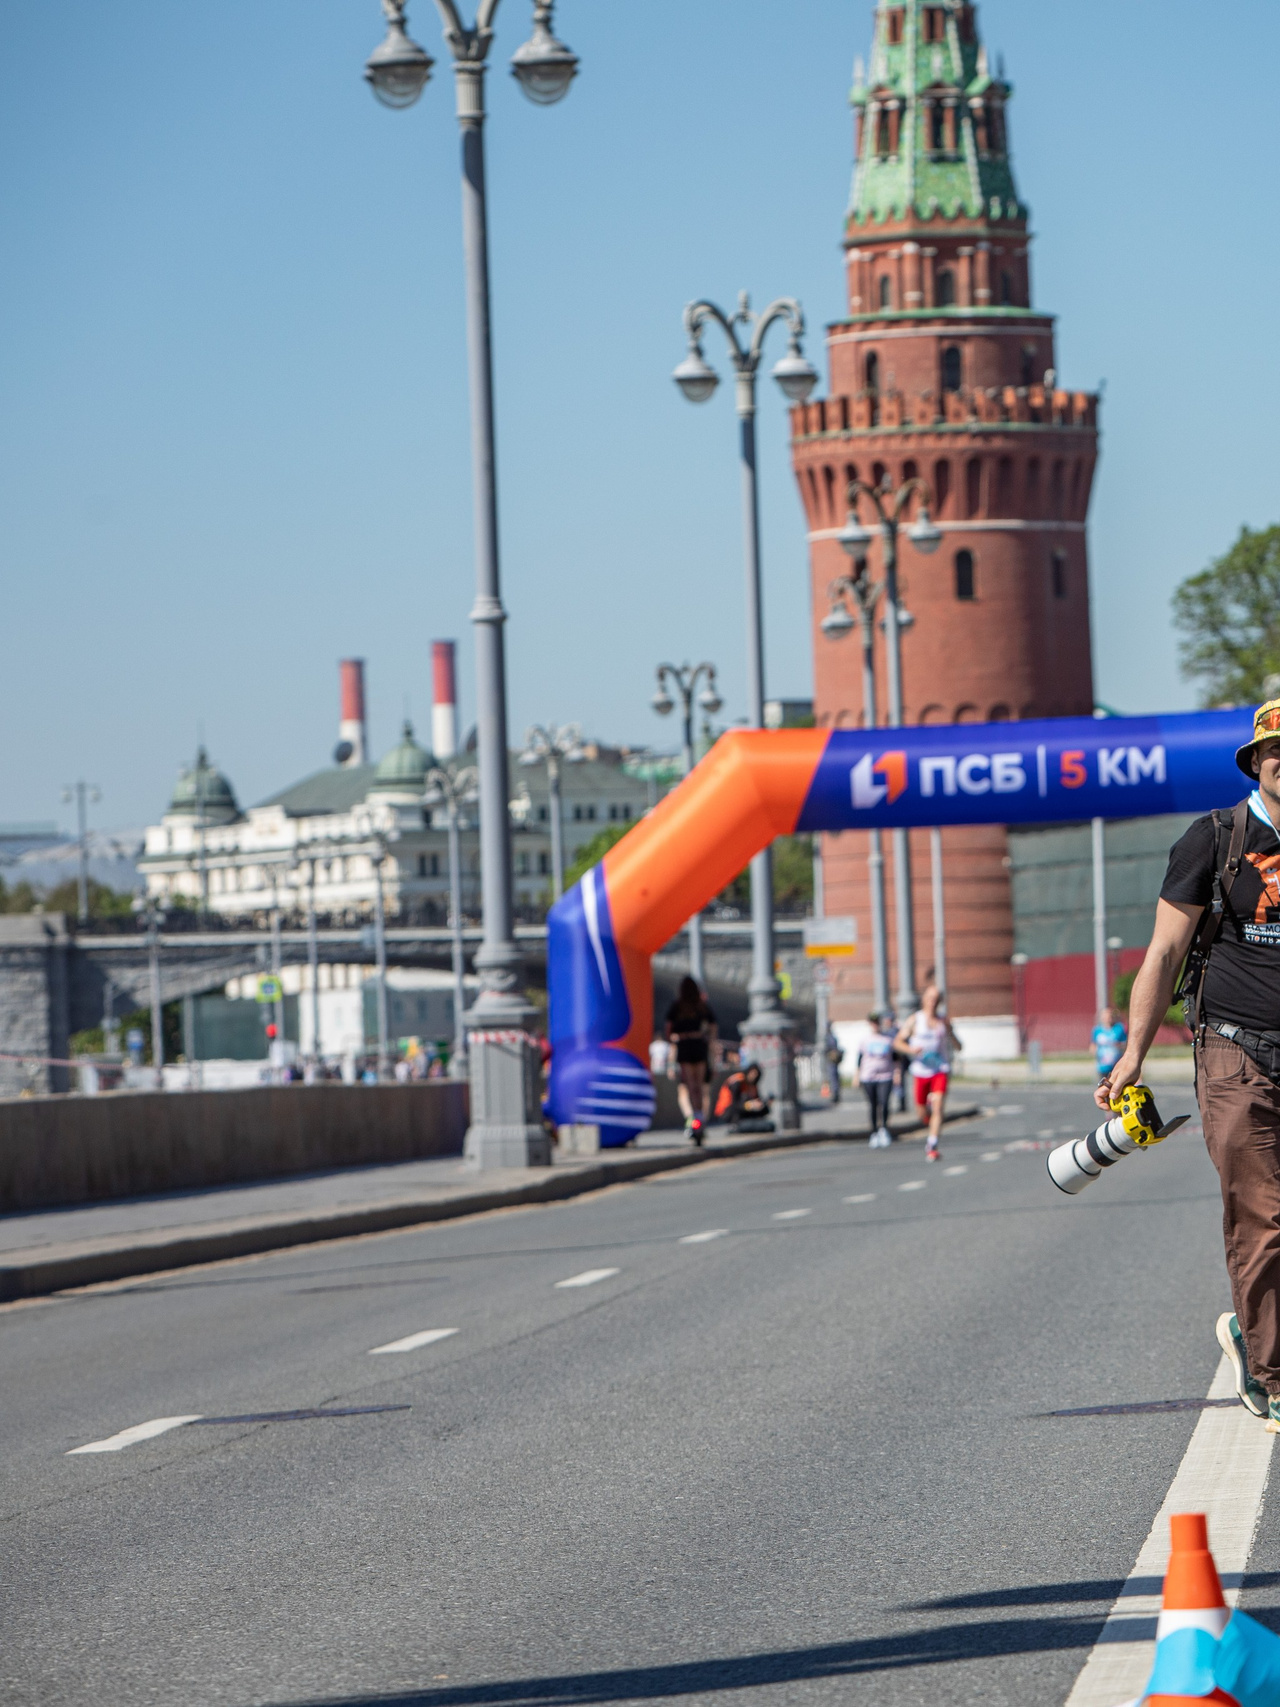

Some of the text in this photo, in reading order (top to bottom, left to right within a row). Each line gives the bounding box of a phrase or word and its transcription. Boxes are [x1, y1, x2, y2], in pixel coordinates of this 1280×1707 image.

[919, 745, 1167, 797] ПСБ 5 КМ
[1245, 933, 1260, 942] КТО
